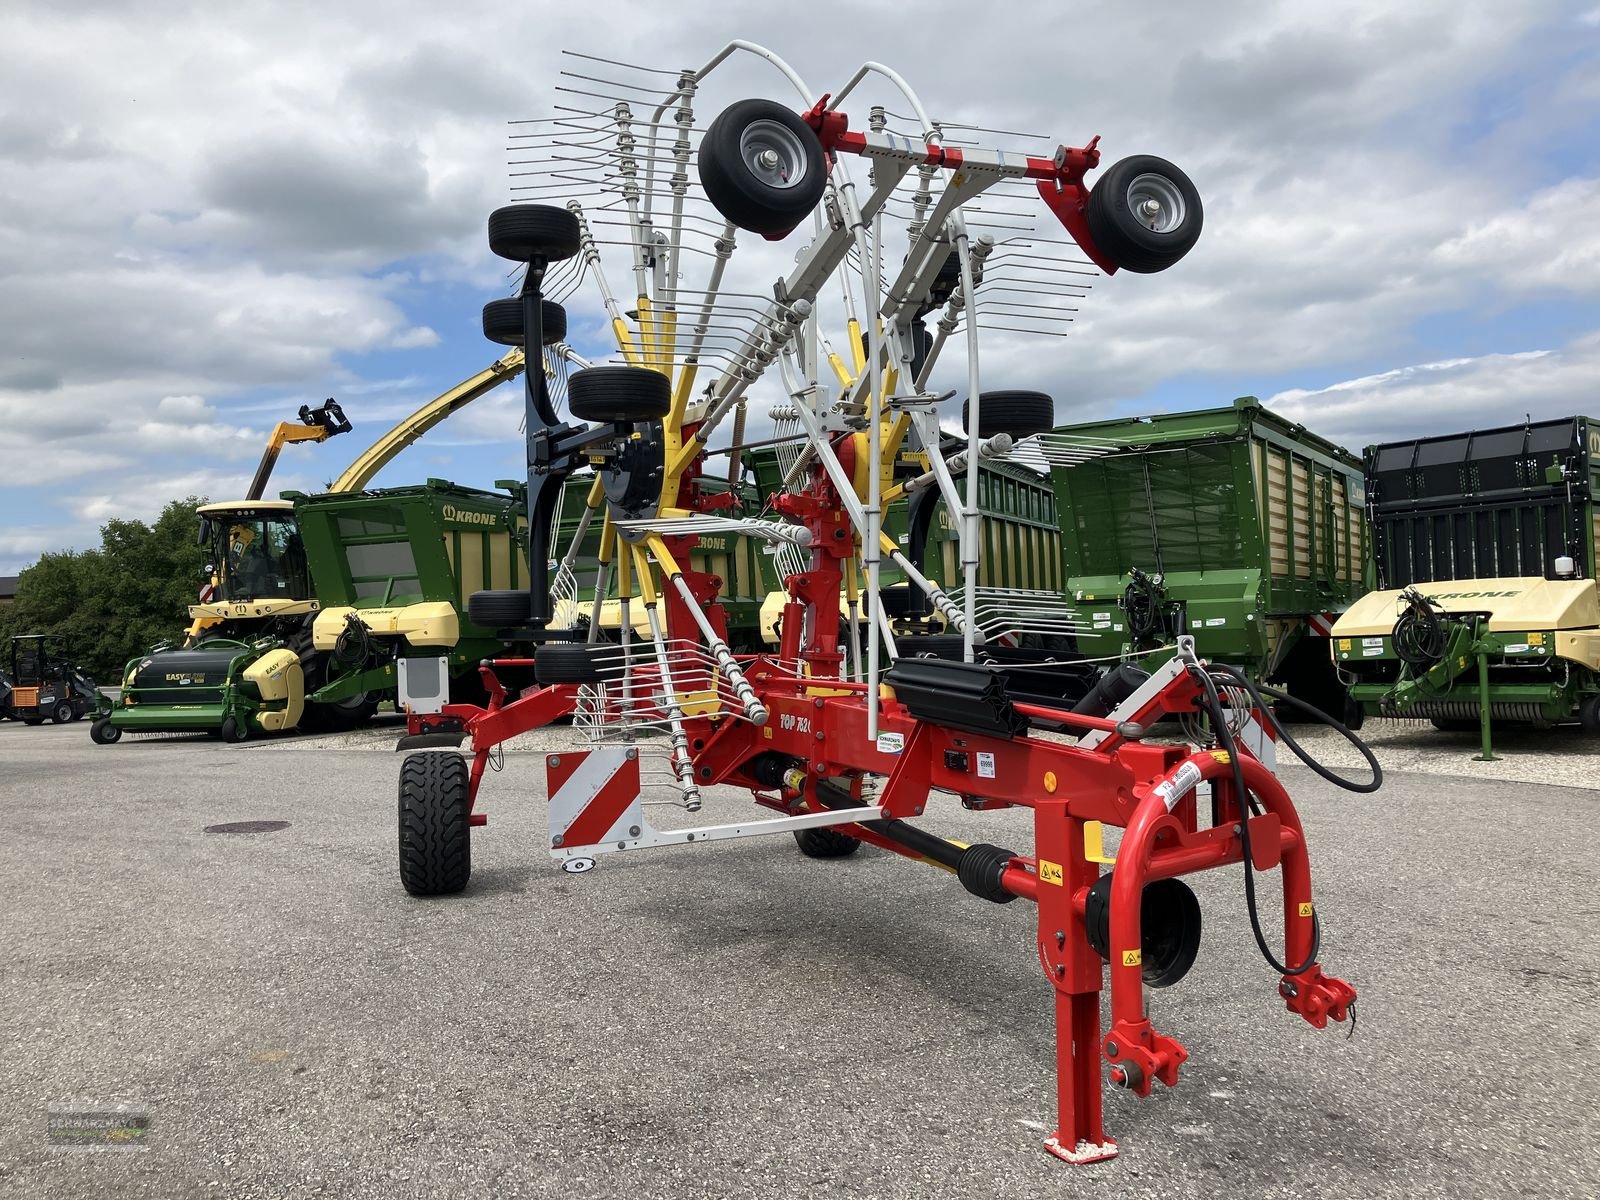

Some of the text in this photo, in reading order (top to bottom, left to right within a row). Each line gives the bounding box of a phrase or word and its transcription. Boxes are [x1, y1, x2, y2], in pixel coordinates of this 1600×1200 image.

[456, 511, 497, 526] KRONE
[1429, 591, 1522, 599] KRONE
[265, 662, 280, 675] EASY
[780, 713, 796, 730] TOP
